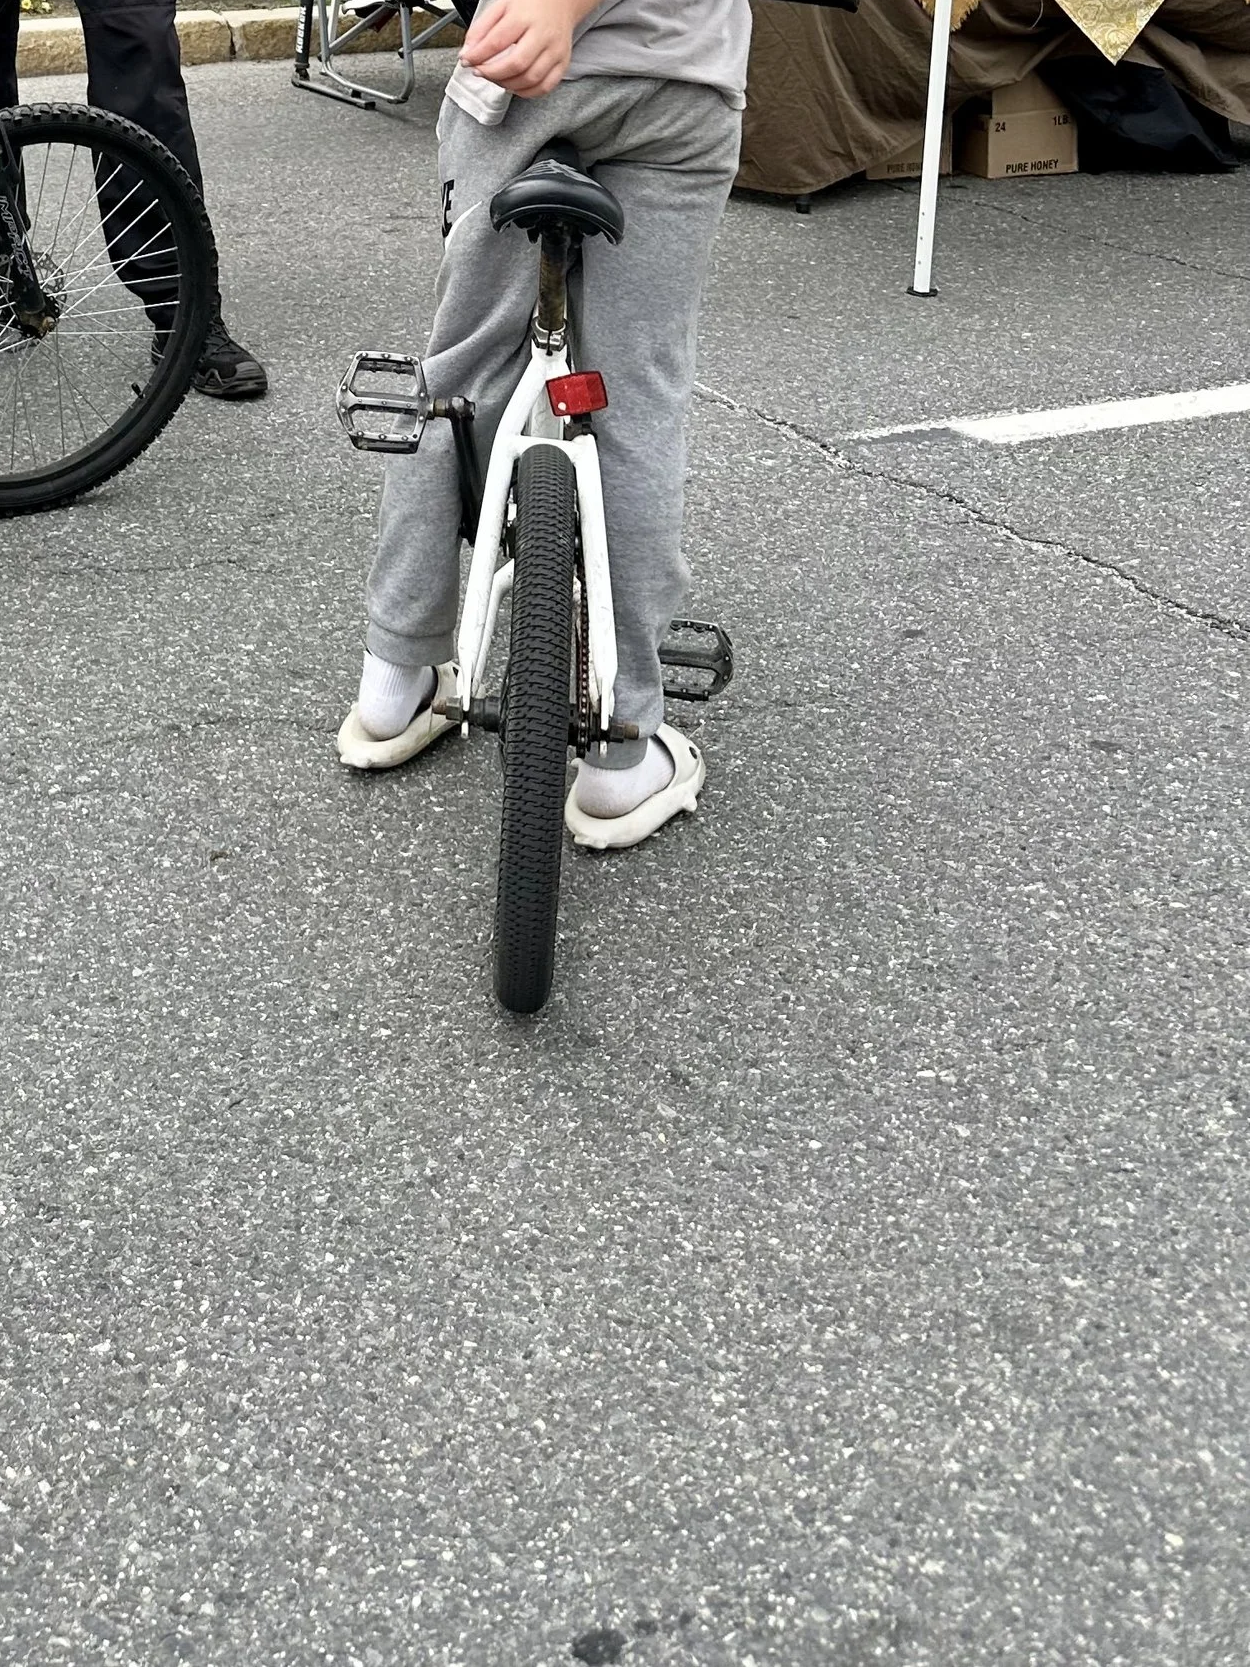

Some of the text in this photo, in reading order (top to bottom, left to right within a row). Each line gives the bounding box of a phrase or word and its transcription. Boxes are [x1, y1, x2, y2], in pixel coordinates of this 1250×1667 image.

[995, 122, 1006, 132] 24
[1006, 159, 1059, 174] PURE HONEY
